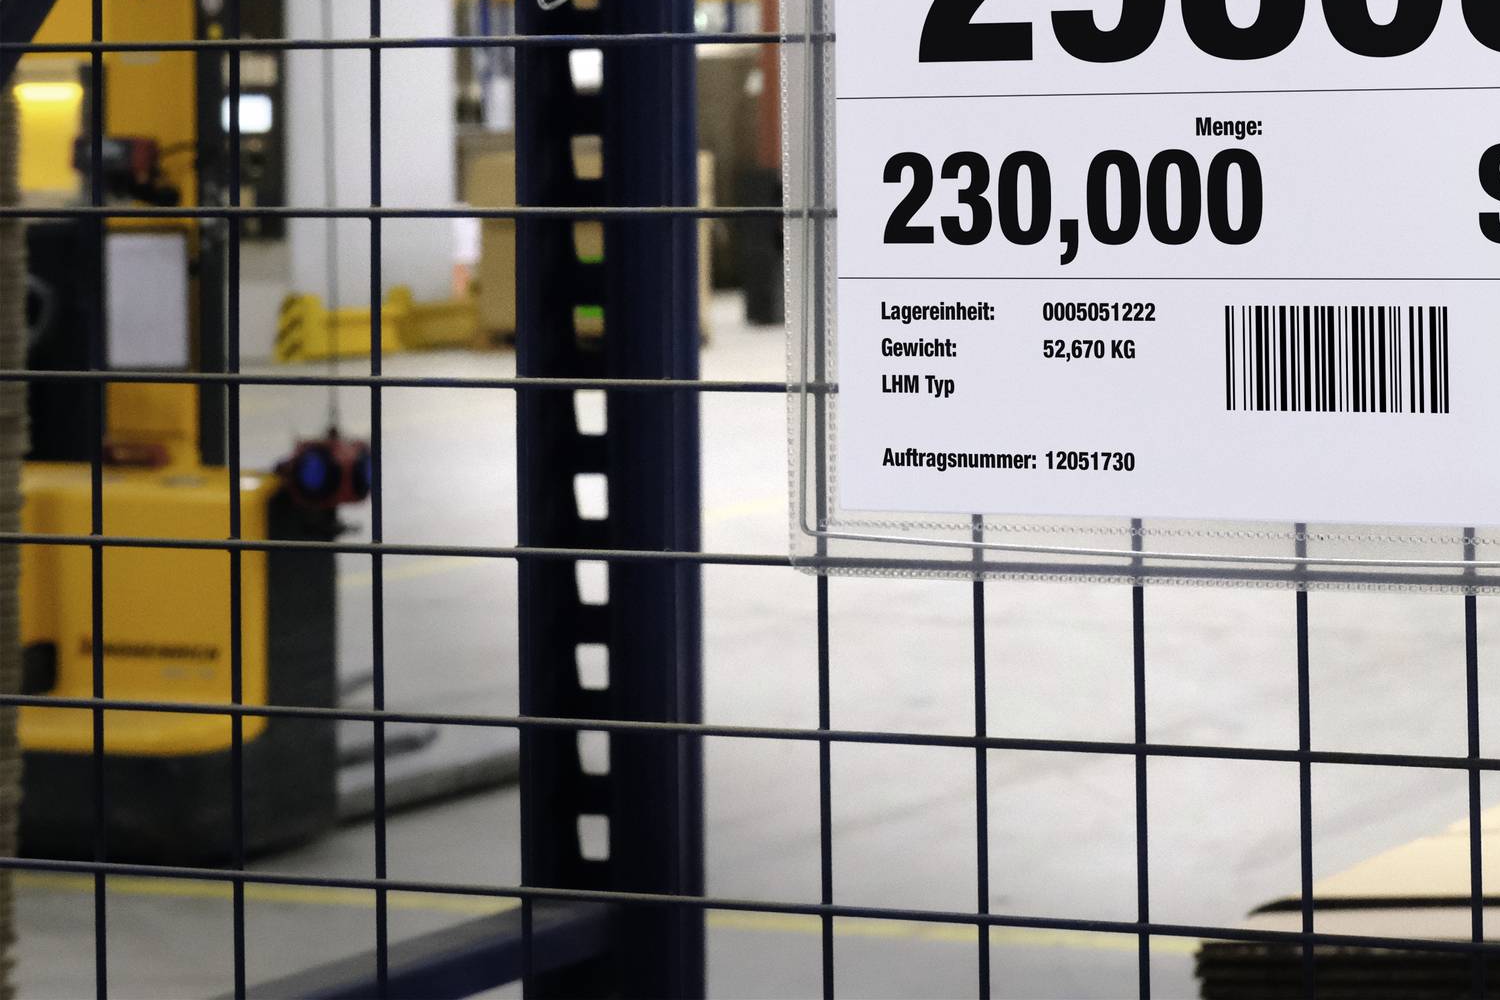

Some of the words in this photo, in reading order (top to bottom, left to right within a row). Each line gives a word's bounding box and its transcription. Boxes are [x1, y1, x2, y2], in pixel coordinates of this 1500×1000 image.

[1195, 116, 1263, 141] Menge:
[882, 147, 1264, 266] 230,000
[881, 301, 995, 325] Lagereinheit:
[1042, 302, 1156, 322] 0005051222
[881, 337, 957, 361] Gewicht:
[1043, 339, 1105, 363] 52,670
[1111, 339, 1136, 360] KG
[881, 374, 920, 394] LHM
[924, 374, 955, 399] Typ
[882, 447, 1037, 472] Auftragsnummer:
[1045, 450, 1136, 472] 12051730
